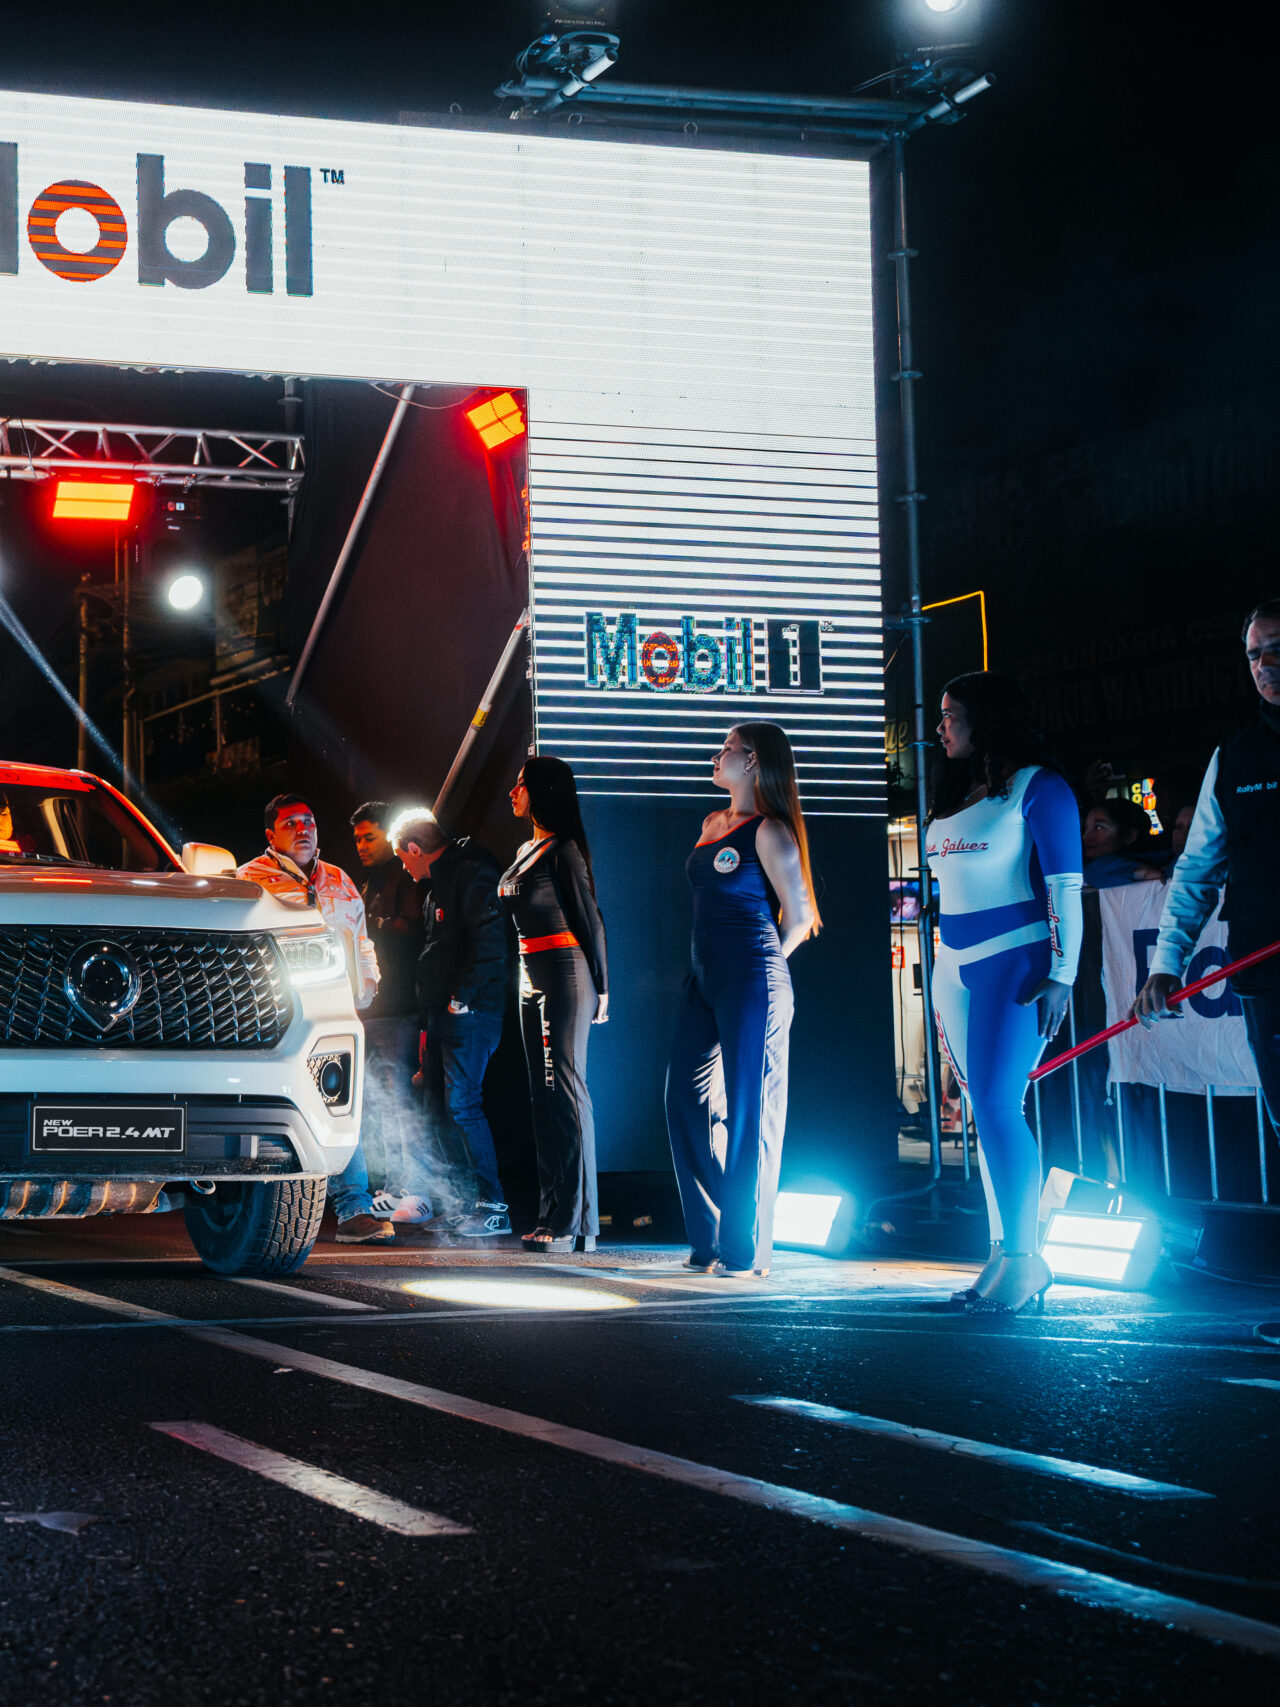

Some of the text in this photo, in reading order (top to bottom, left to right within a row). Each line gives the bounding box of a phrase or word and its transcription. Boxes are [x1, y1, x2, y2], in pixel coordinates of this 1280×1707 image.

[584, 611, 756, 694] Mobil
[42, 1127, 175, 1139] POER 2.4 MT
